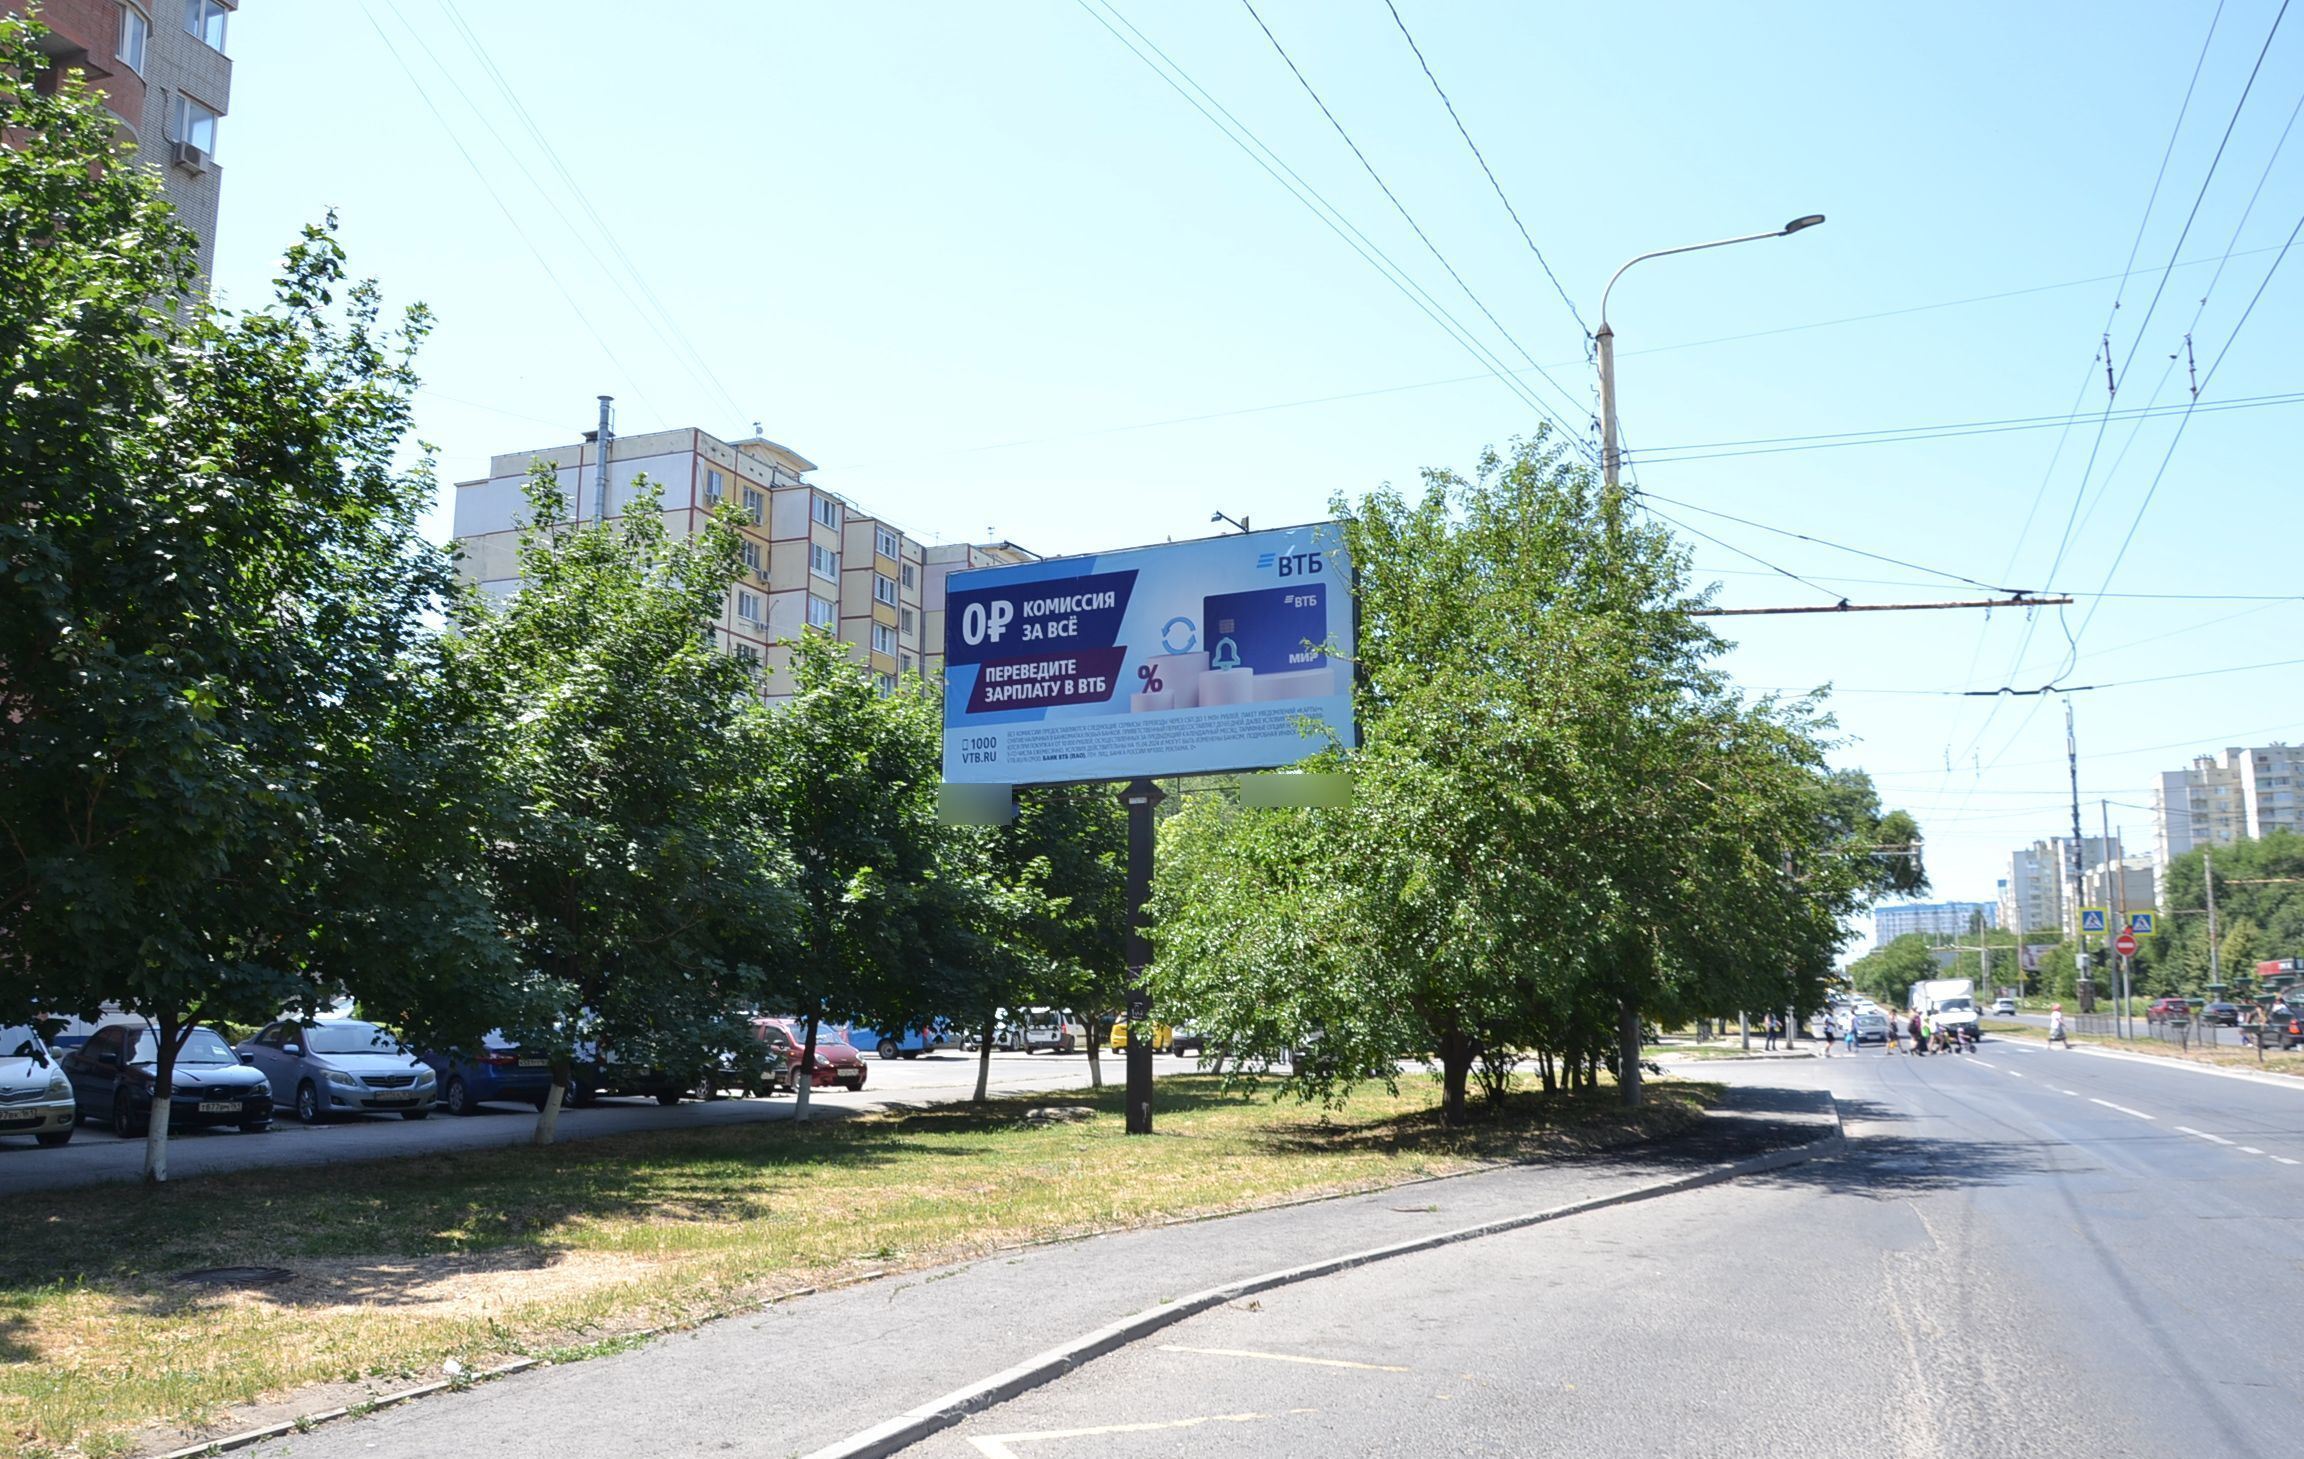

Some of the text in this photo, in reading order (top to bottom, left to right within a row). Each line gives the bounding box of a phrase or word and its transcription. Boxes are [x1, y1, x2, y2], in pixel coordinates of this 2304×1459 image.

[1279, 552, 1323, 577] ВТБ
[1023, 591, 1115, 617] КОМИССИЯ
[1295, 595, 1317, 608] ВТБ
[1022, 615, 1078, 641] ЗА ВСЁ
[1289, 652, 1318, 664] МИР
[986, 659, 1077, 682] ПЕРЕВЕДИТЕ
[985, 677, 1106, 702] ЗАРПЛАТУ В ВТБ
[971, 737, 997, 750] 1000
[962, 752, 997, 764] VTB.RU
[1059, 753, 1069, 761] ВТБ
